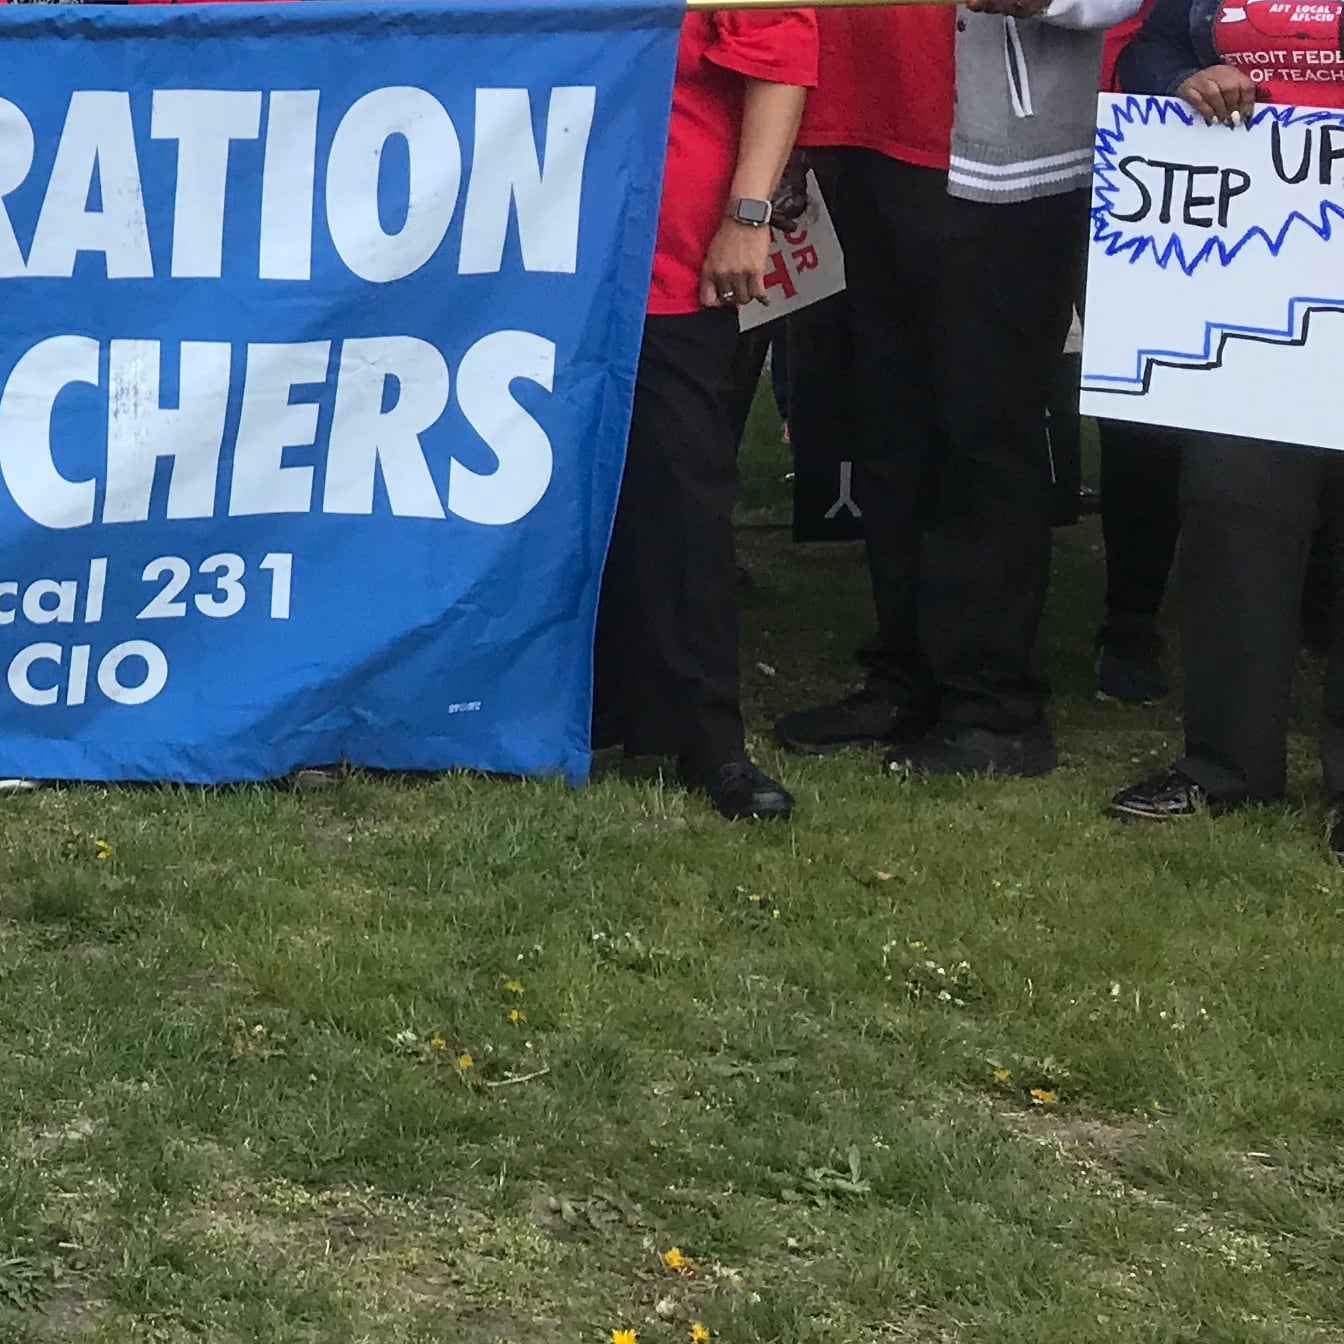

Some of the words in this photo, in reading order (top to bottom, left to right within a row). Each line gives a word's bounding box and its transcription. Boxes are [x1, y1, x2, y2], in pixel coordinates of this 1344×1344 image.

[1269, 4, 1292, 13] AFT
[1296, 4, 1330, 14] LOCAL
[1290, 13, 1335, 22] AFL-CIO
[1250, 69, 1275, 82] OF
[1108, 156, 1251, 228] STEP
[136, 552, 293, 623] 231
